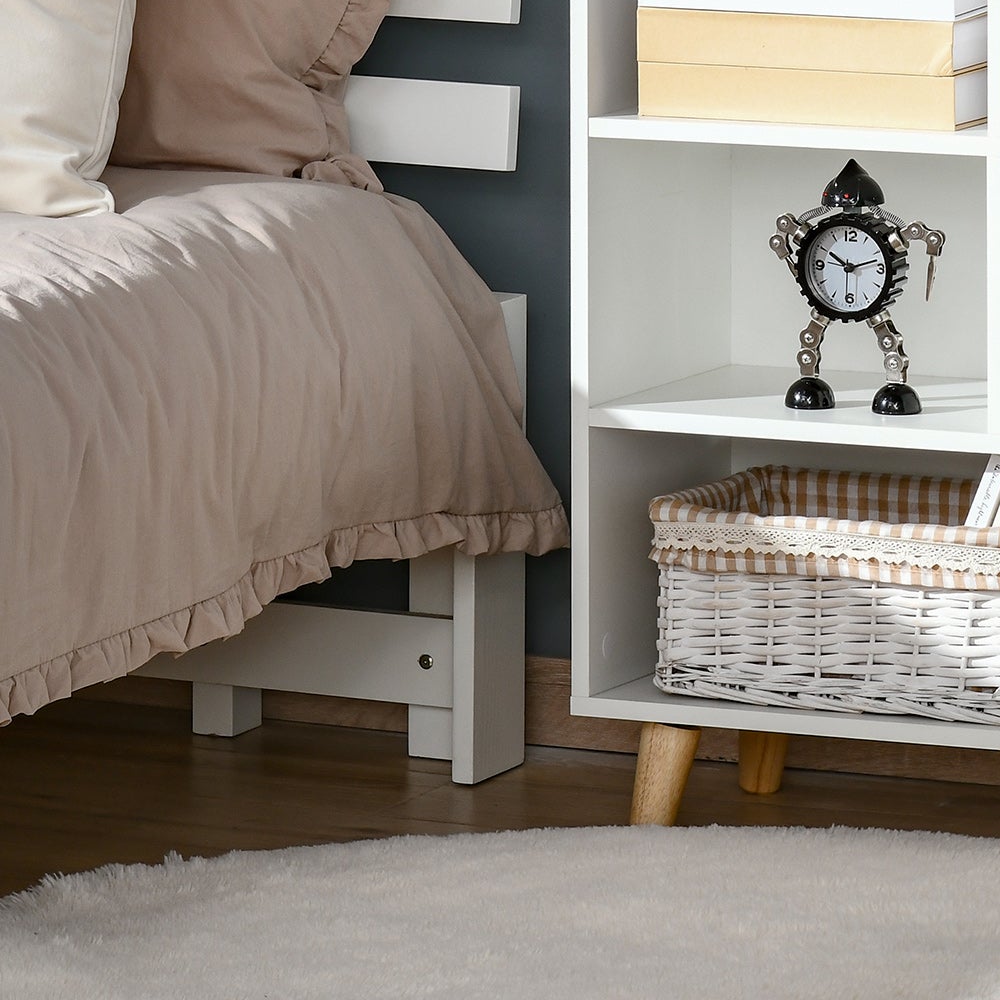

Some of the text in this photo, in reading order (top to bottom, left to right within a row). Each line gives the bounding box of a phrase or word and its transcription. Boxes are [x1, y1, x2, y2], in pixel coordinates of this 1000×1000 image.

[844, 230, 858, 242] 12
[815, 259, 825, 271] 9
[876, 263, 885, 275] 3
[844, 292, 855, 304] 6
